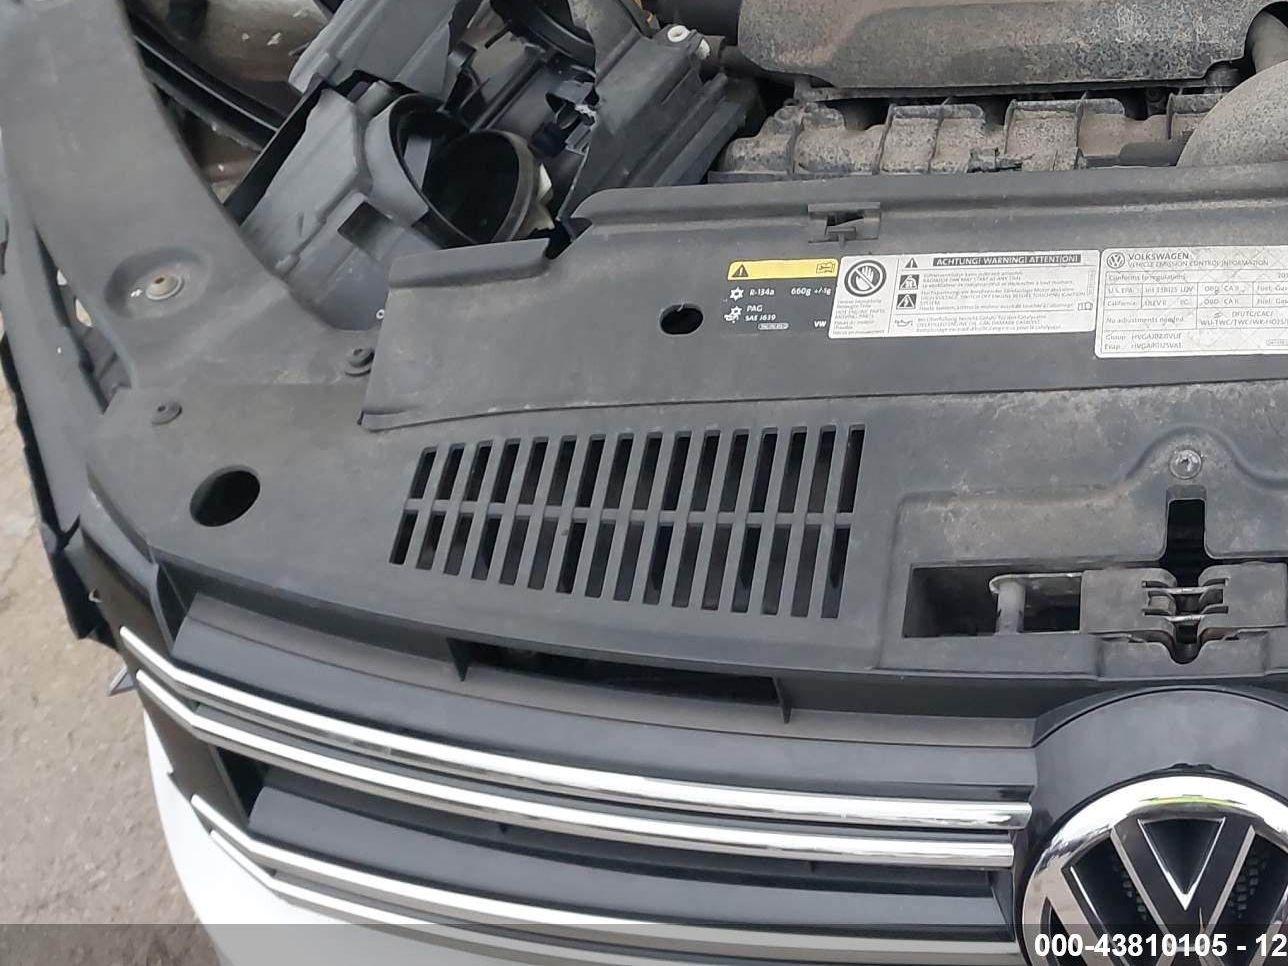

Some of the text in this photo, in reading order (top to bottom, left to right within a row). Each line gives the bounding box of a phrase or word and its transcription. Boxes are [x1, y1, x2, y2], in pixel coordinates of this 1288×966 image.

[936, 255, 1078, 266] ACHTUNG! WARNING! ATTENTION!
[1128, 252, 1189, 261] VOLKSWAGEN
[750, 288, 775, 296] R-134a
[791, 288, 811, 296] 660g
